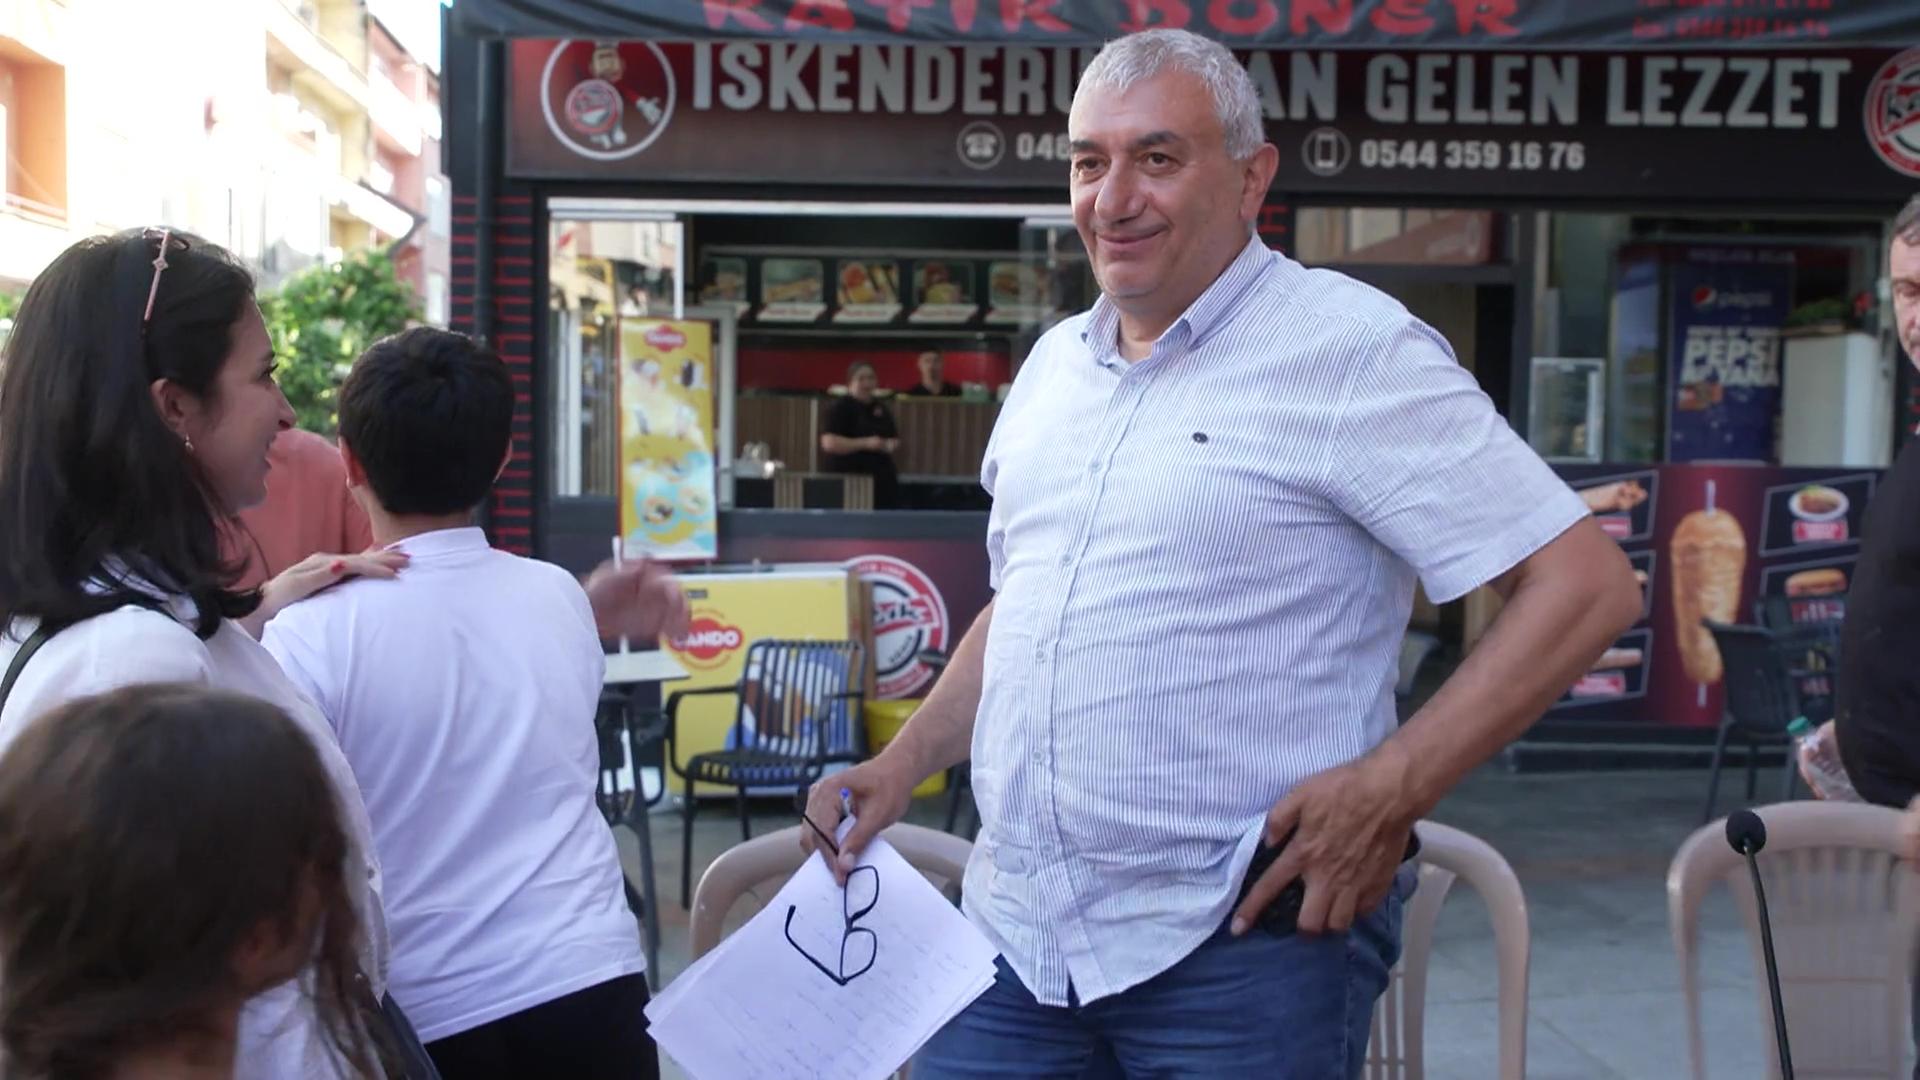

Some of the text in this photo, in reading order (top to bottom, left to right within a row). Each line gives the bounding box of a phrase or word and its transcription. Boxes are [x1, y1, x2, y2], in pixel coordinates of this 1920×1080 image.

[693, 41, 1095, 114] ISKENDERU
[1243, 52, 1338, 121] AN
[1364, 54, 1579, 124] GELEN
[1605, 57, 1852, 129] LEZZET
[1016, 132, 1071, 161] 046
[1361, 140, 1586, 170] 0544 359 16 76
[672, 630, 741, 649] ANDO
